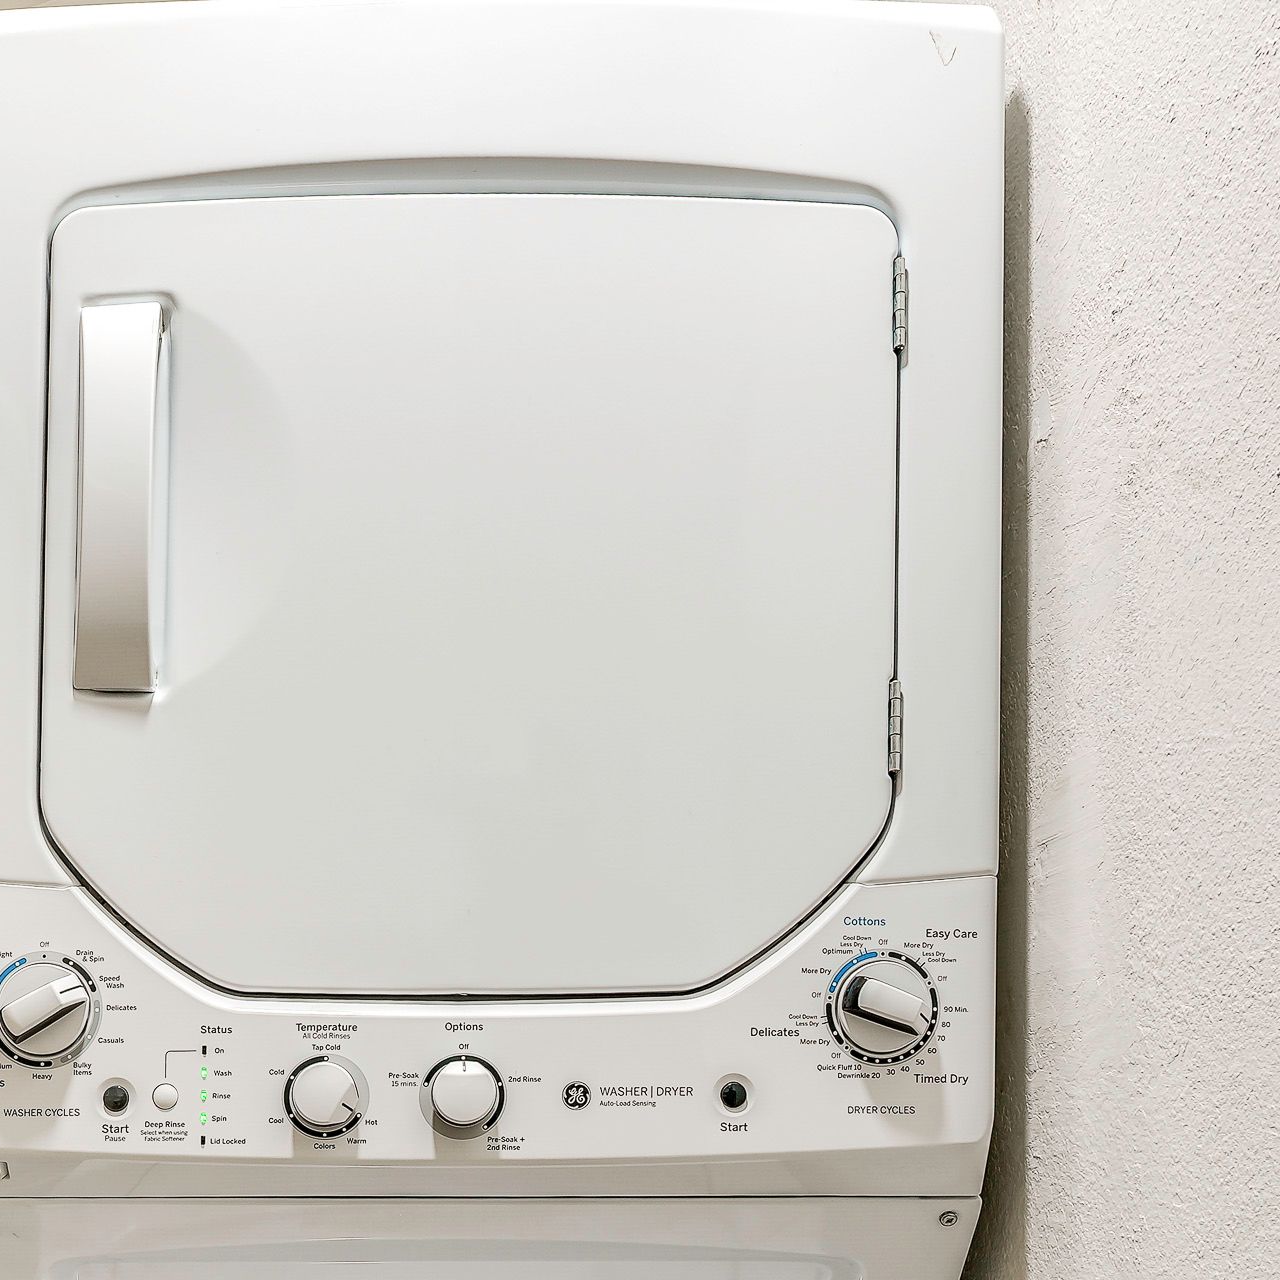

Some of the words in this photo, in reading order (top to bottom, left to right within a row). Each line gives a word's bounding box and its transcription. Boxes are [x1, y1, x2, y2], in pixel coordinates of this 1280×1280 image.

[844, 917, 886, 926] Cottons
[926, 929, 950, 939] Easy
[952, 929, 977, 938] Care
[200, 1026, 232, 1034] Status
[296, 1023, 358, 1032] Temperature
[445, 1022, 483, 1032] Options
[751, 1028, 799, 1037] Delicates
[914, 1074, 946, 1083] Timed
[950, 1074, 968, 1085] Dry
[600, 1087, 647, 1096] WASHER
[657, 1087, 693, 1096] DRYER
[848, 1106, 878, 1114] DRYER
[880, 1106, 915, 1114] CYCLES
[102, 1124, 129, 1133] Start
[720, 1123, 748, 1132] Start
